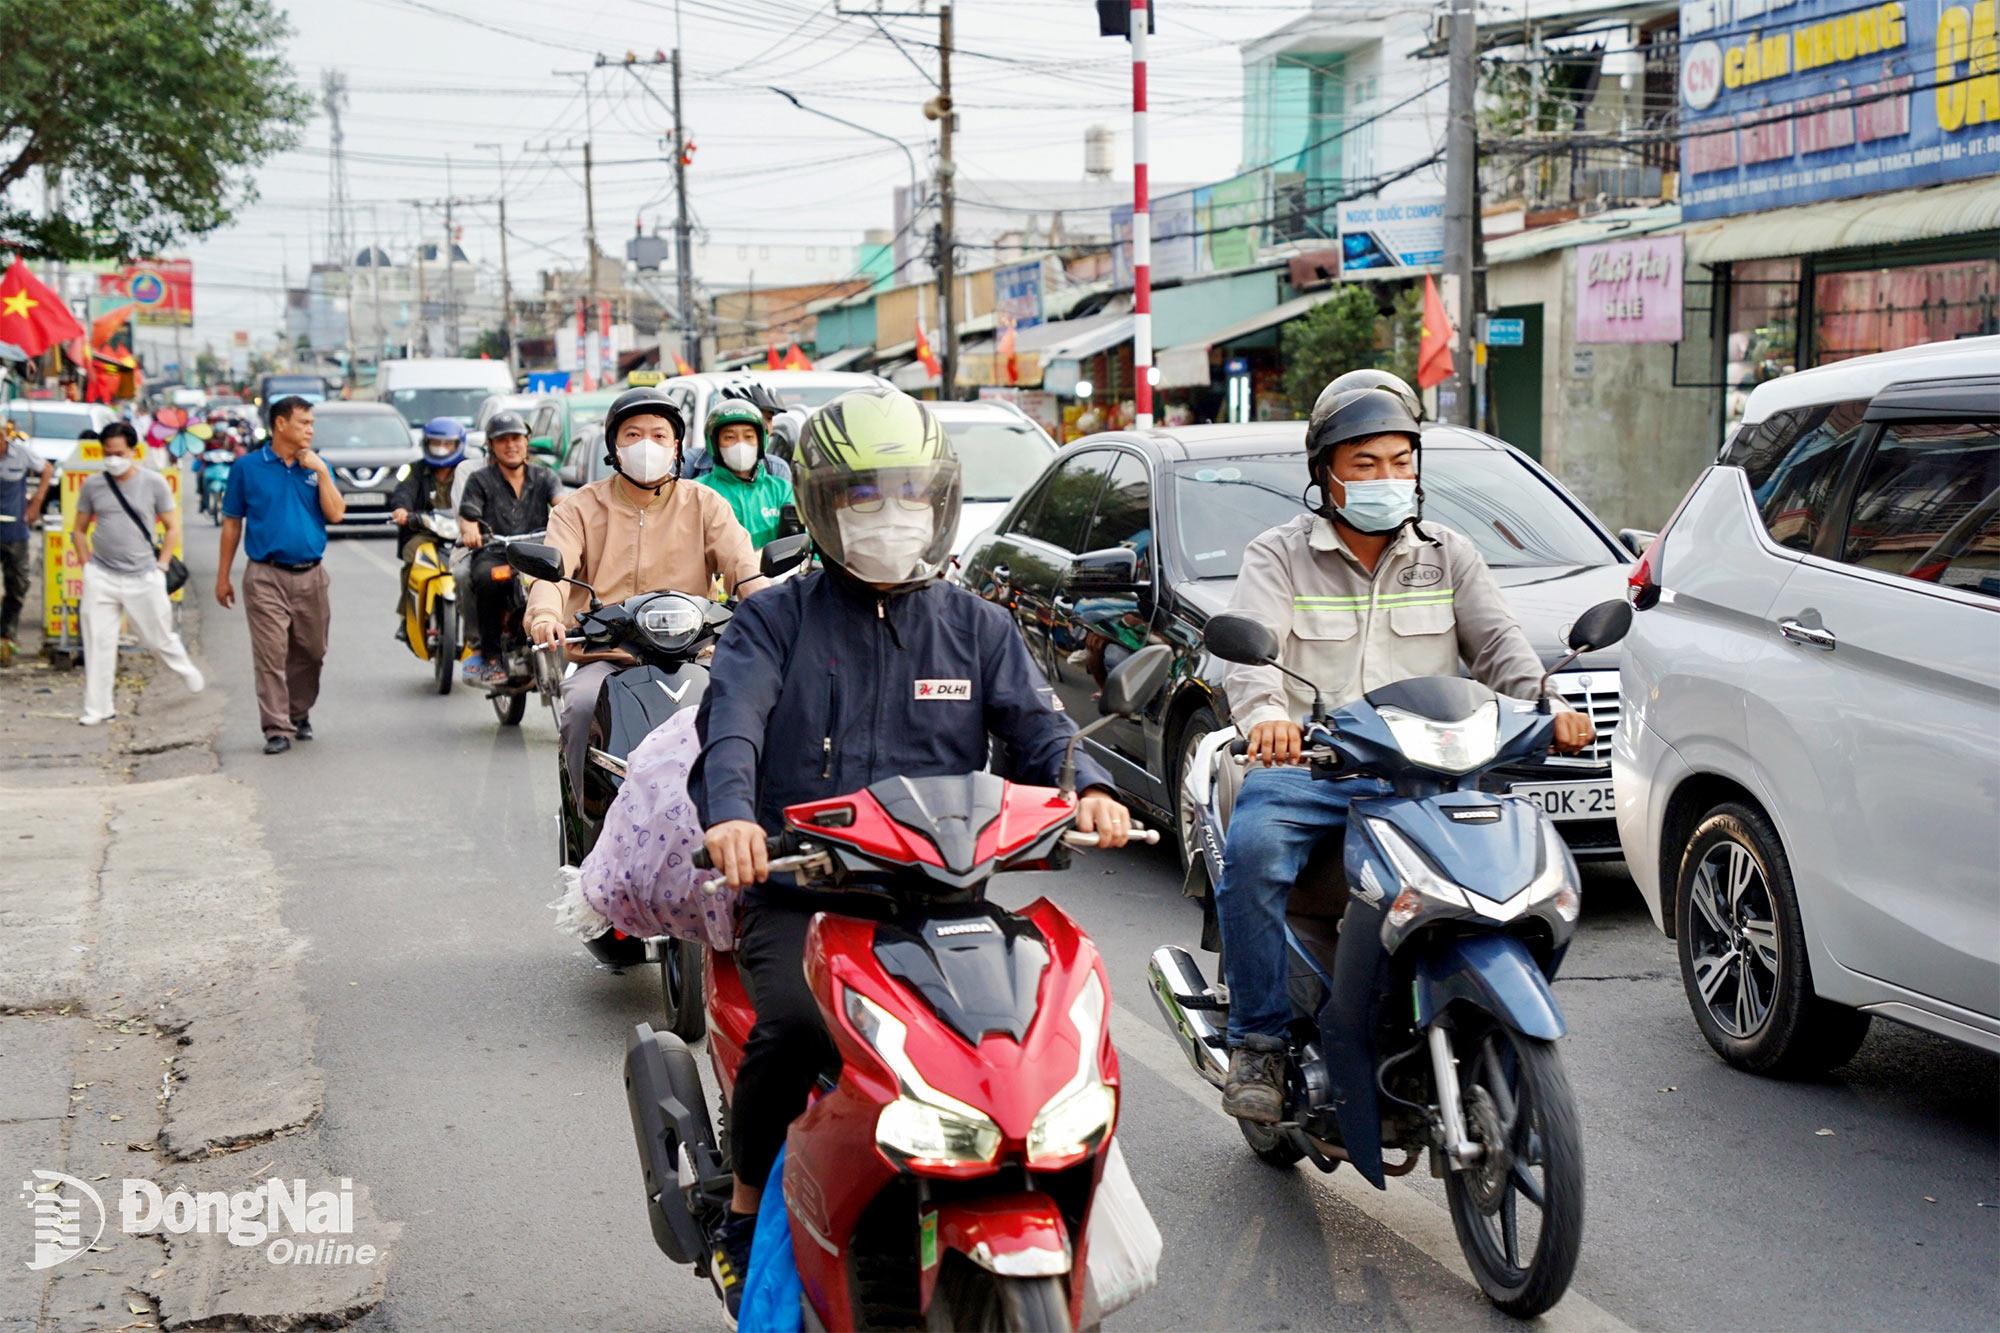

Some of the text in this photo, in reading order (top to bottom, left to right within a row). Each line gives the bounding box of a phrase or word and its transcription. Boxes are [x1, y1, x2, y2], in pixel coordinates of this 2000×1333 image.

[1793, 3, 1906, 72] NHUNG
[1687, 60, 1714, 92] CN
[936, 922, 993, 937] HONDA
